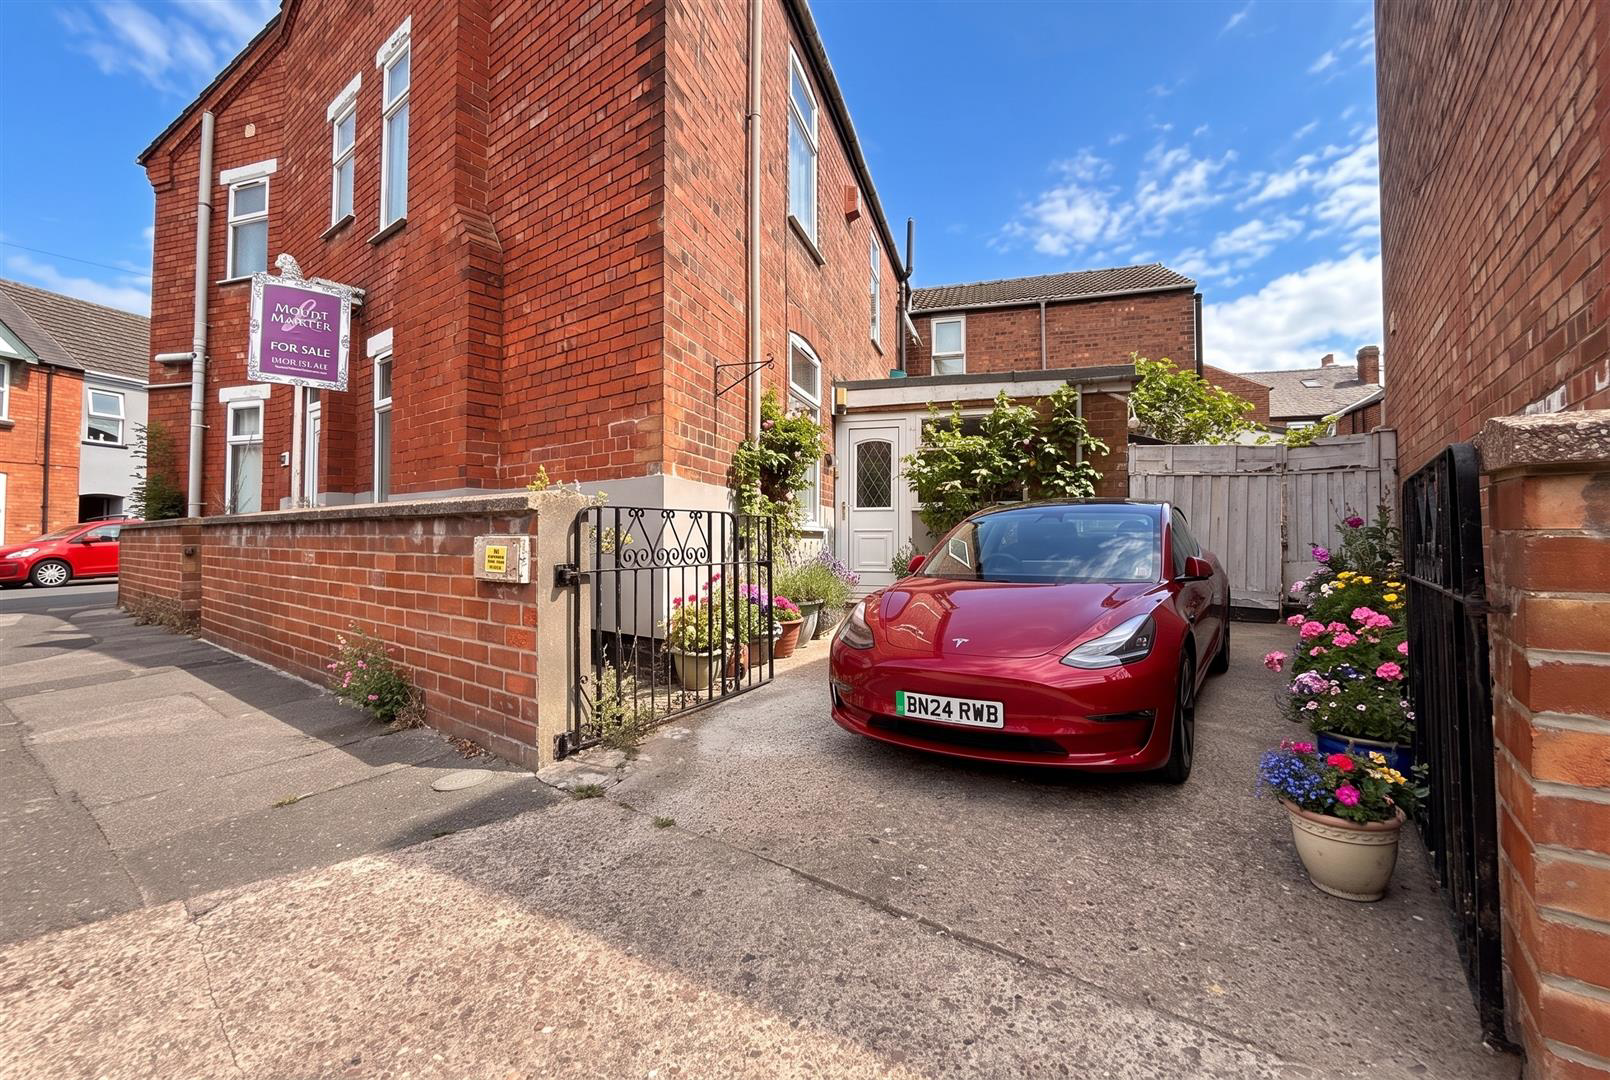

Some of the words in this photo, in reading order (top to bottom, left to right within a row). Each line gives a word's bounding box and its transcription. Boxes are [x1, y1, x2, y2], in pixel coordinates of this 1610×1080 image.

[270, 341, 299, 354] FOR
[301, 345, 331, 358] SALE
[906, 696, 953, 718] BN24
[959, 702, 998, 723] RWB
